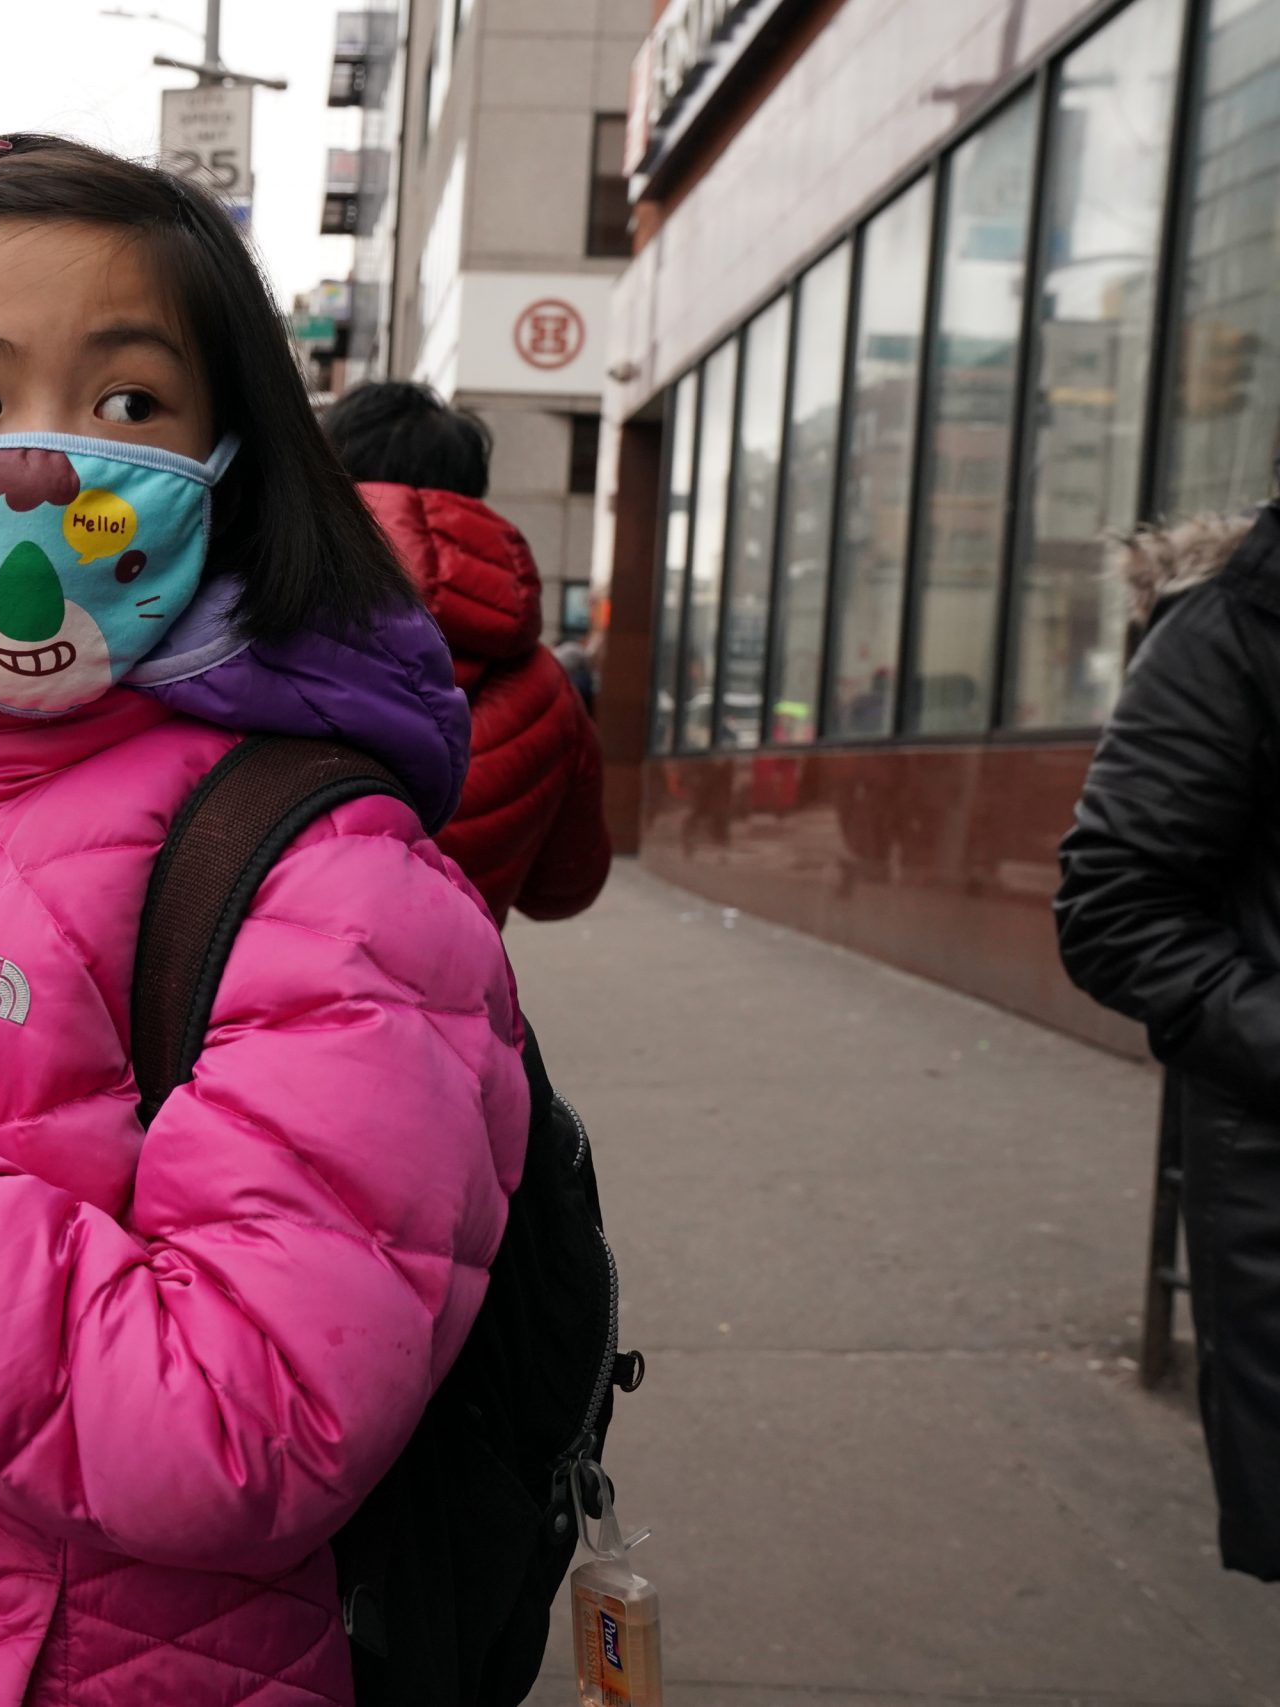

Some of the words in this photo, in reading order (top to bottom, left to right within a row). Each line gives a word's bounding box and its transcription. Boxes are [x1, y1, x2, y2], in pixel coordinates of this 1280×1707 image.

[175, 149, 239, 189] 25
[73, 513, 126, 534] Hello!
[604, 1618, 619, 1664] Purell
